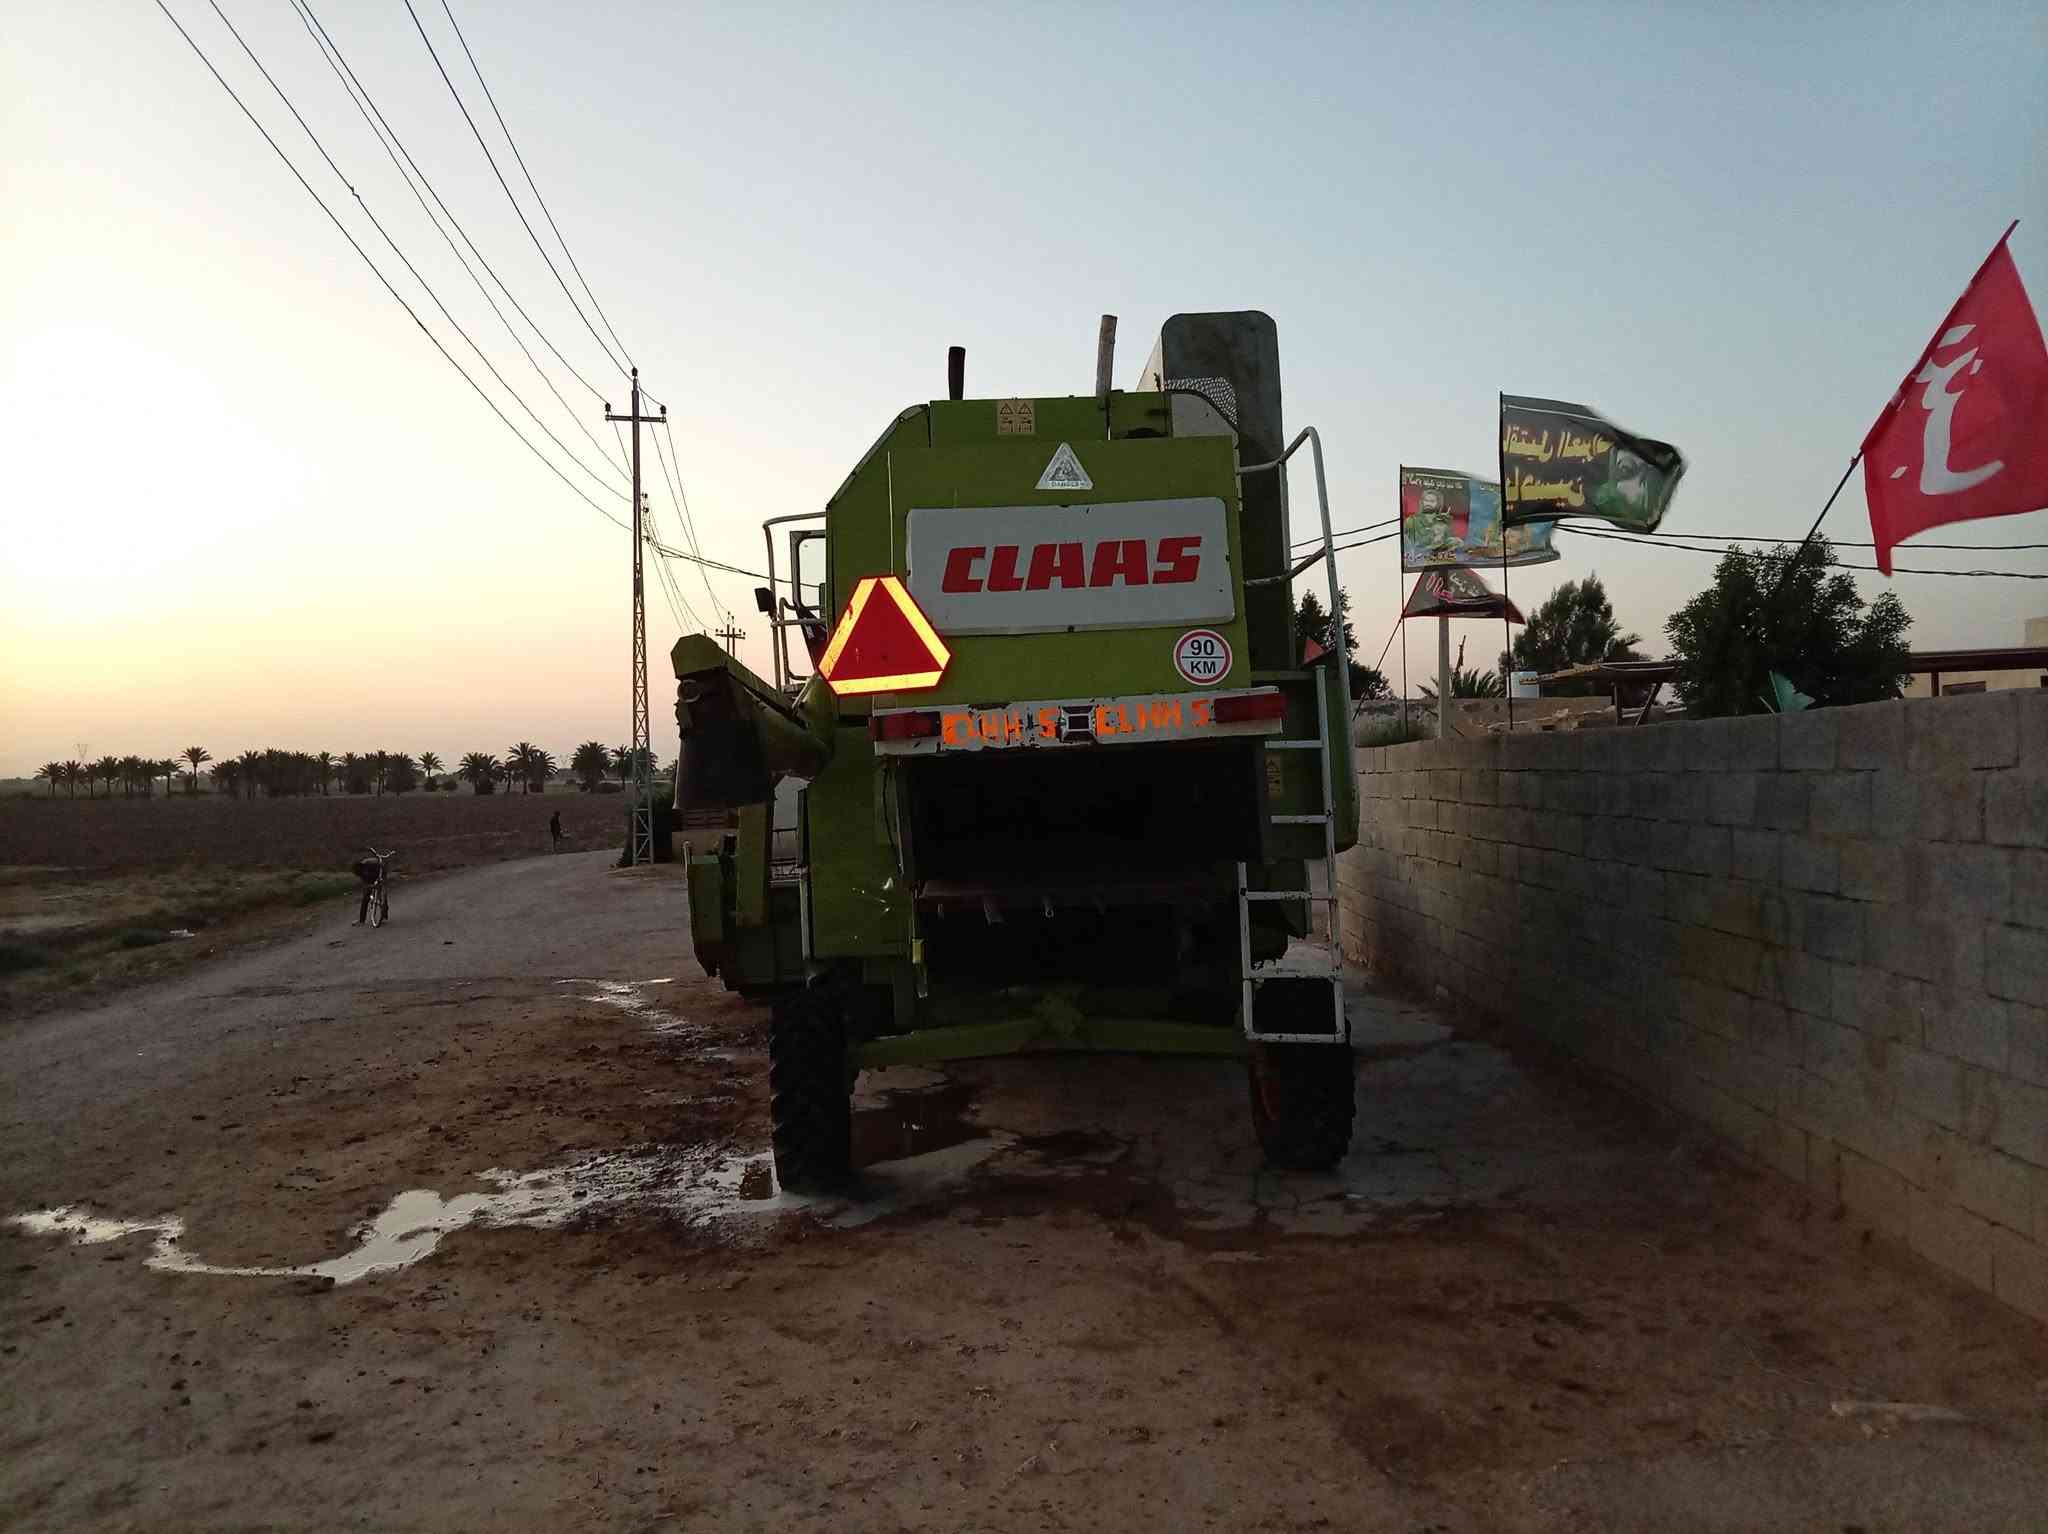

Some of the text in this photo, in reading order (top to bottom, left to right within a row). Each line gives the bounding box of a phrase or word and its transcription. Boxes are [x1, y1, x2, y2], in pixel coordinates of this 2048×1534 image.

[941, 536, 1203, 594] CLAAS
[1190, 639, 1215, 656] 90
[1190, 660, 1216, 674] KM
